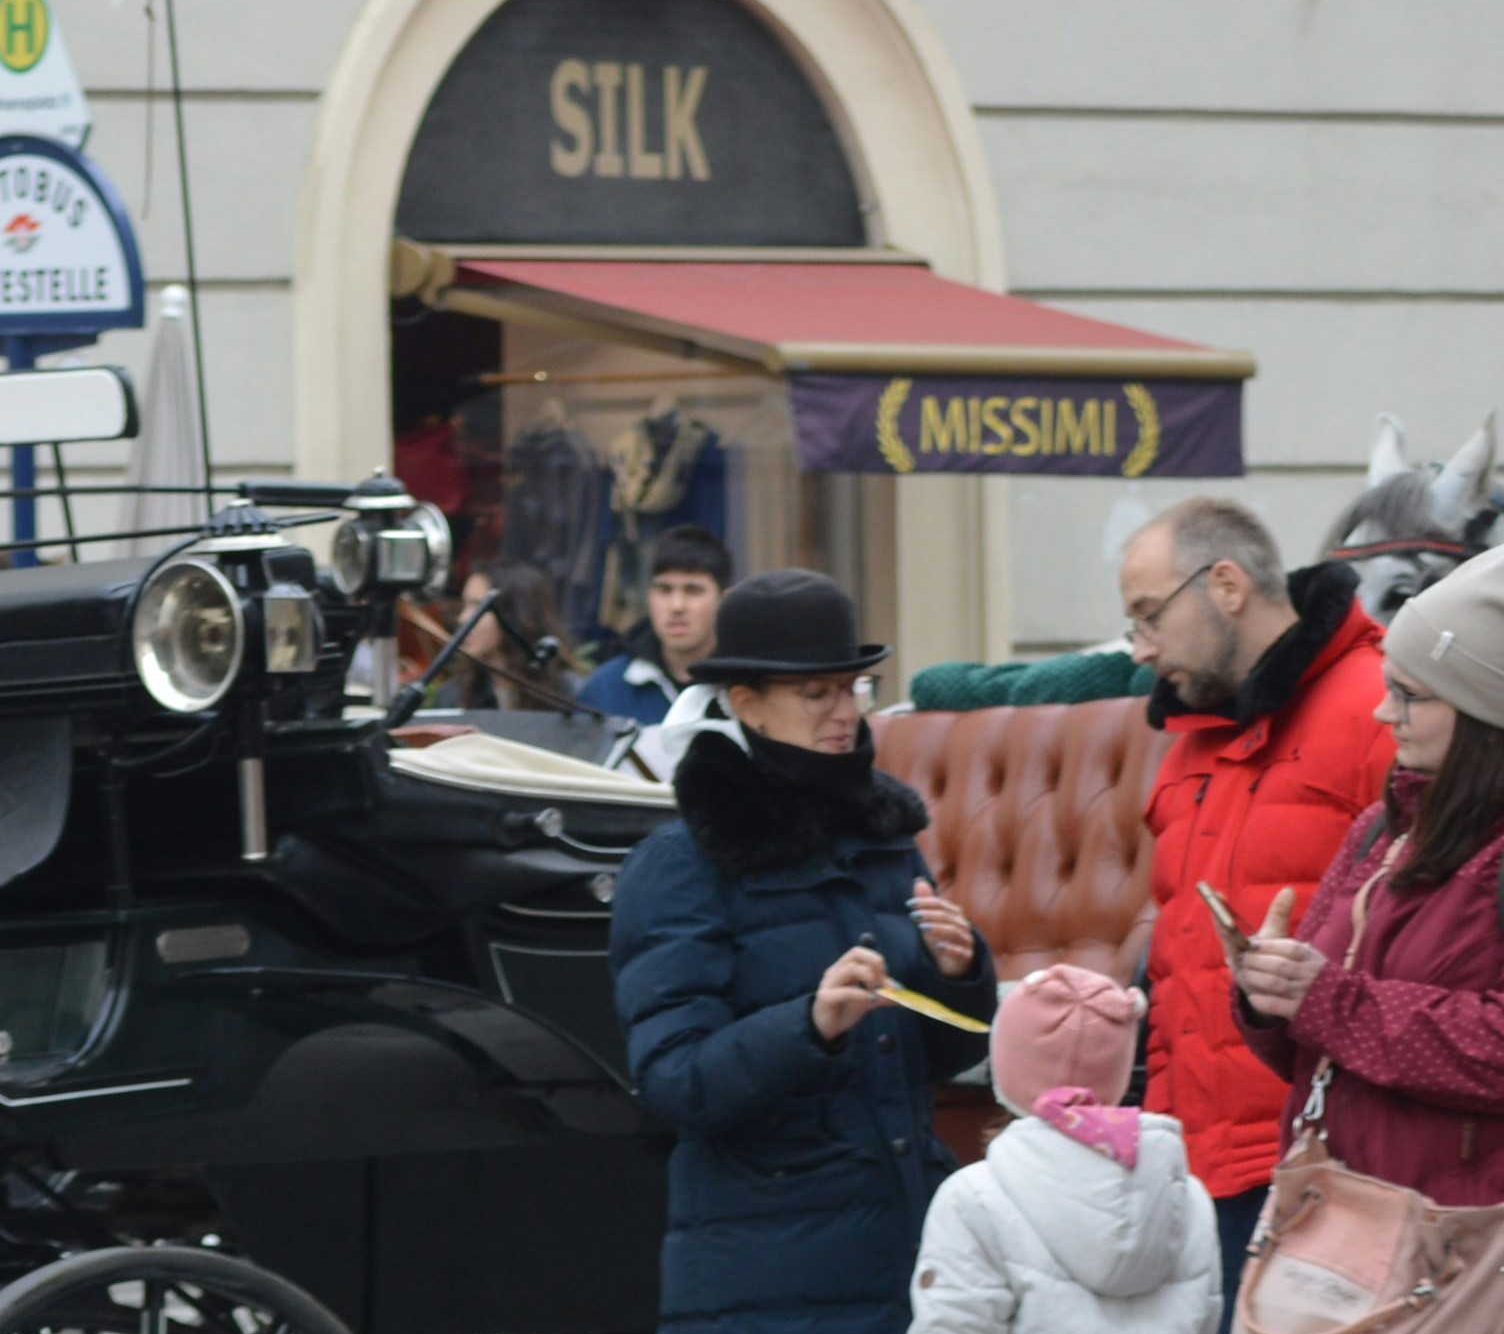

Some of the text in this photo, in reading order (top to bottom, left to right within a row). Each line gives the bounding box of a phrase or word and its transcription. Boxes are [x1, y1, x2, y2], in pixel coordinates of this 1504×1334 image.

[5, 0, 36, 55] H
[549, 58, 711, 183] SILK
[919, 395, 1117, 458] MISSIMI
